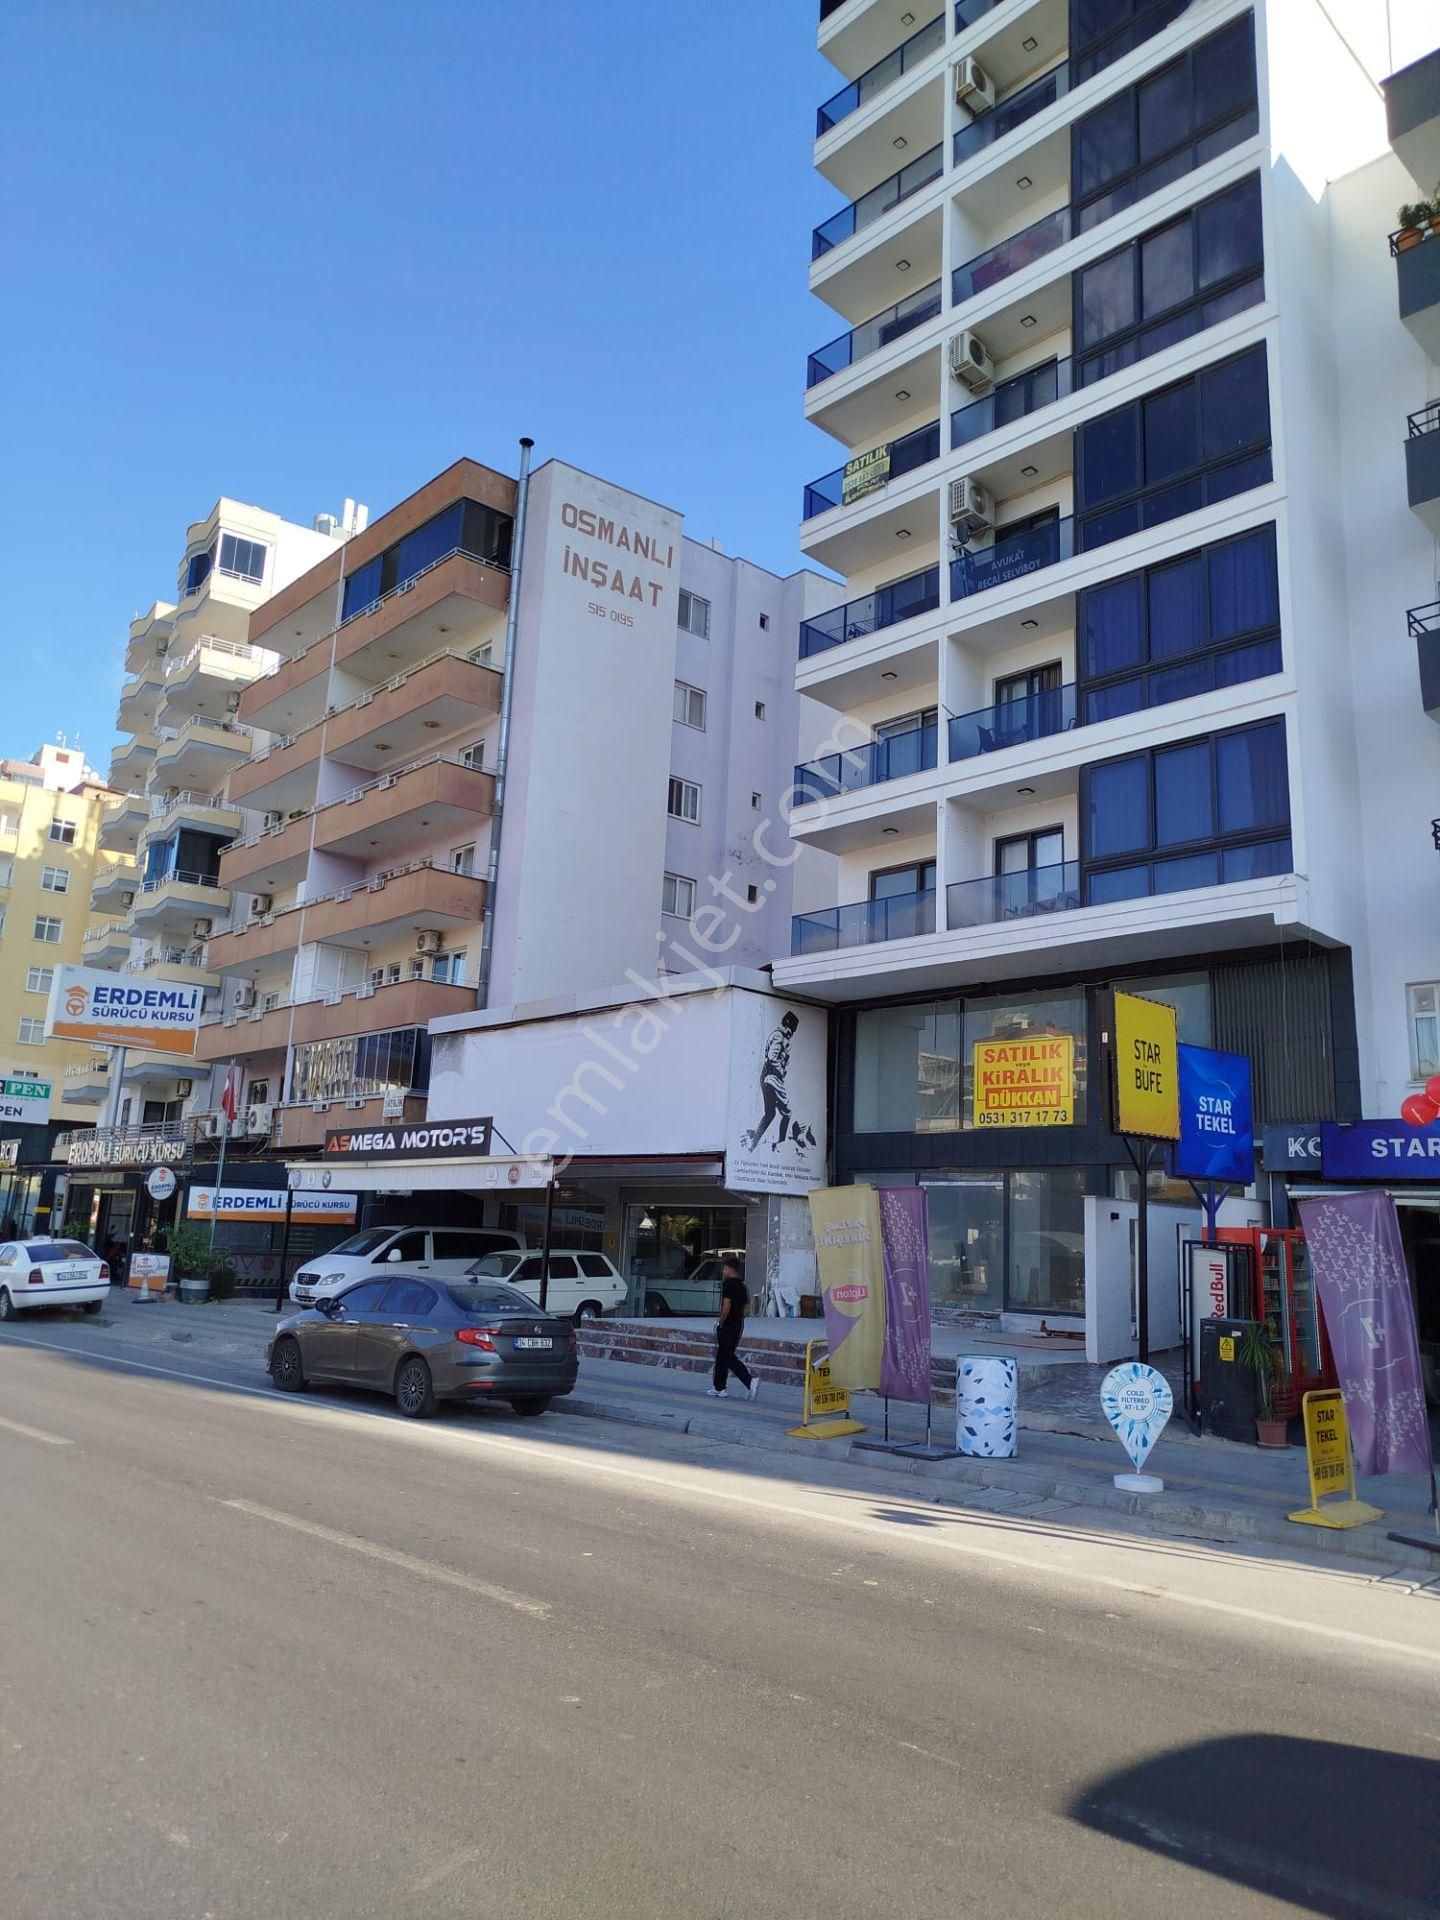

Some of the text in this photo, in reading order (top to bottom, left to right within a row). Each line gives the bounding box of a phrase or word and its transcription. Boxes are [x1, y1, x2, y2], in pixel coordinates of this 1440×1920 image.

[846, 445, 887, 475] SATILIK
[561, 502, 673, 568] OSMANLI
[991, 550, 1025, 571] AVUKAT
[563, 545, 663, 607] İNŞAAT
[93, 986, 198, 1009] ERDEMLİ
[92, 1005, 194, 1022] SÜRÜCÜ KURSU
[1134, 1039, 1161, 1065] STAR
[9, 1082, 47, 1097] PEN
[1135, 1065, 1163, 1094] BÜFE
[988, 1089, 1057, 1107] DÜKKAN
[1199, 1095, 1232, 1116] STAR
[979, 1110, 1068, 1124] 0531 317 17 73
[1195, 1114, 1236, 1134] TEKEL
[400, 1126, 486, 1149] MOTOR'S
[1371, 1138, 1440, 1157] STAR
[150, 1141, 185, 1161] KURSU
[211, 1194, 350, 1209] ERDEMLİ ÜRÜCÜ KURSU
[1209, 1263, 1225, 1318] Red Bull
[1121, 1396, 1150, 1404] FILTERED
[1126, 1389, 1145, 1397] COLD
[1317, 1409, 1335, 1423] STAR
[1316, 1428, 1339, 1444] TEKEL
